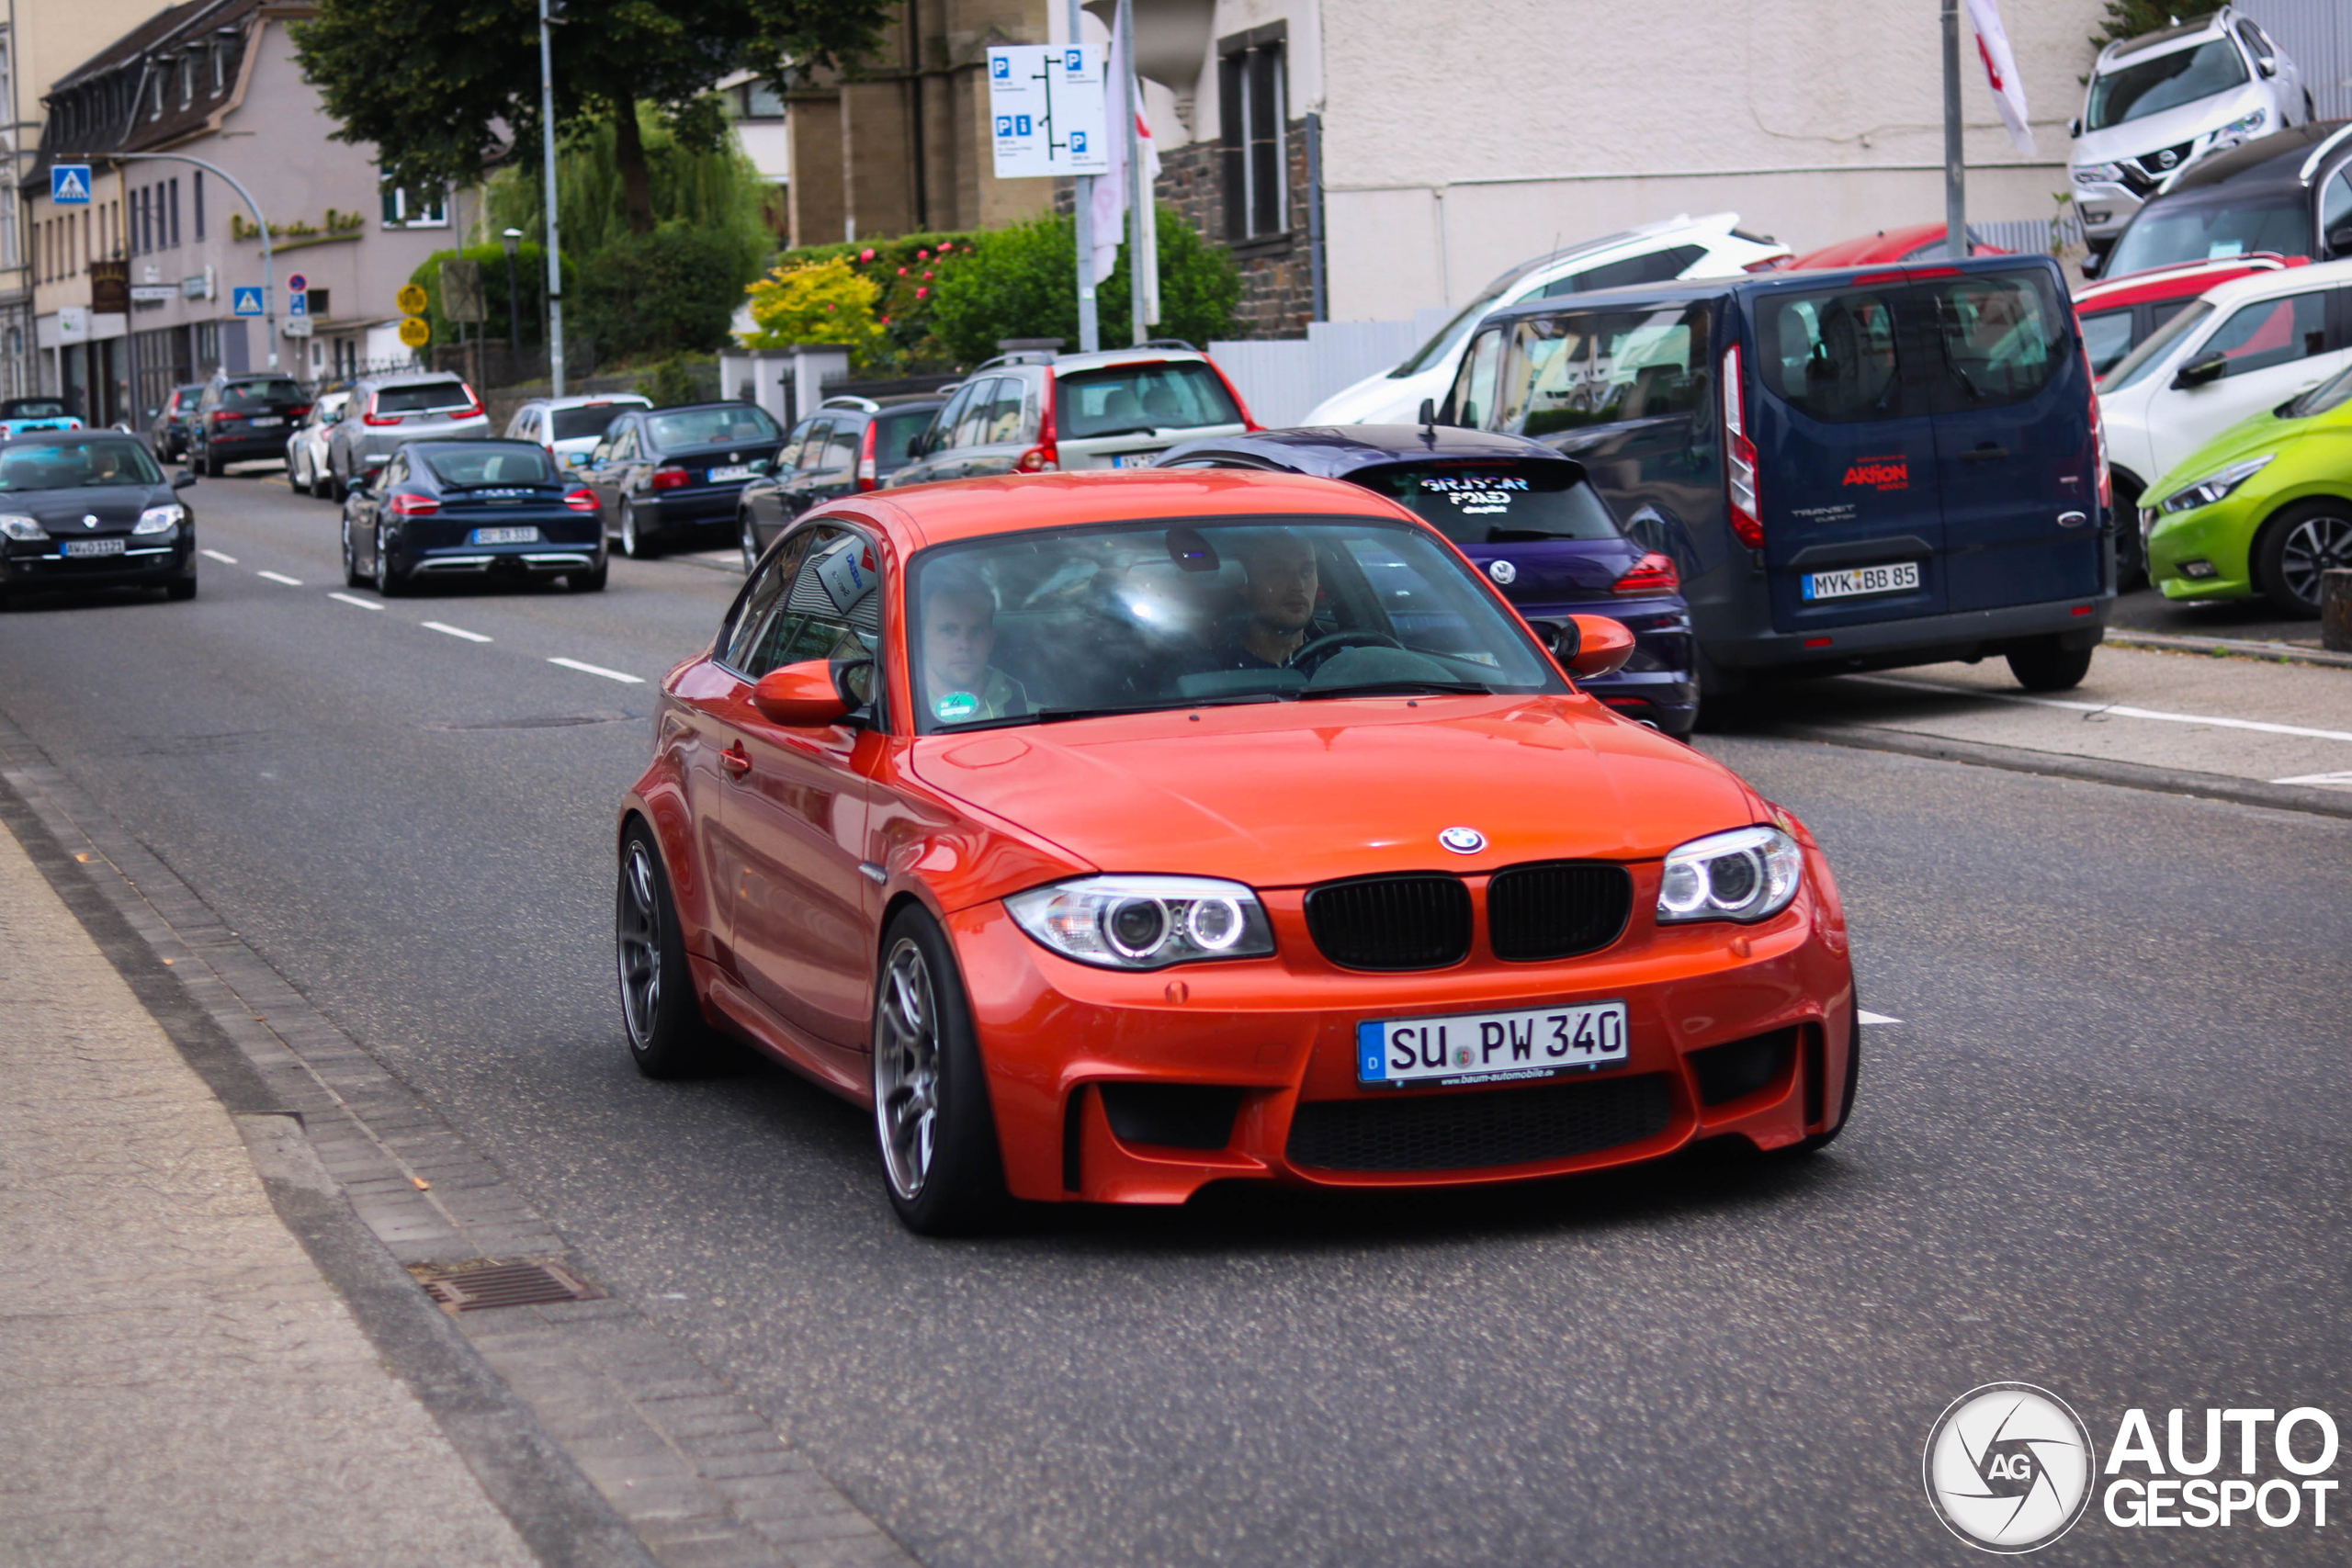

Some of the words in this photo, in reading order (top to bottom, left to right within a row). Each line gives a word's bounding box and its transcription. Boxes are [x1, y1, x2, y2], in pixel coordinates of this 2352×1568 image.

[994, 60, 1007, 75] P
[1068, 52, 1080, 68] P
[998, 118, 1010, 134] P
[1072, 134, 1084, 150] P
[1792, 503, 1856, 517] TRANSIT
[1814, 573, 1853, 596] MYK
[1862, 569, 1889, 590] BB
[1893, 565, 1917, 586] 85
[1390, 1025, 1447, 1070] SU
[1479, 1018, 1533, 1065] PW
[1545, 1010, 1622, 1057] 340
[1368, 1056, 1378, 1070] D
[1441, 1068, 1555, 1086] www.baum-automobile.de
